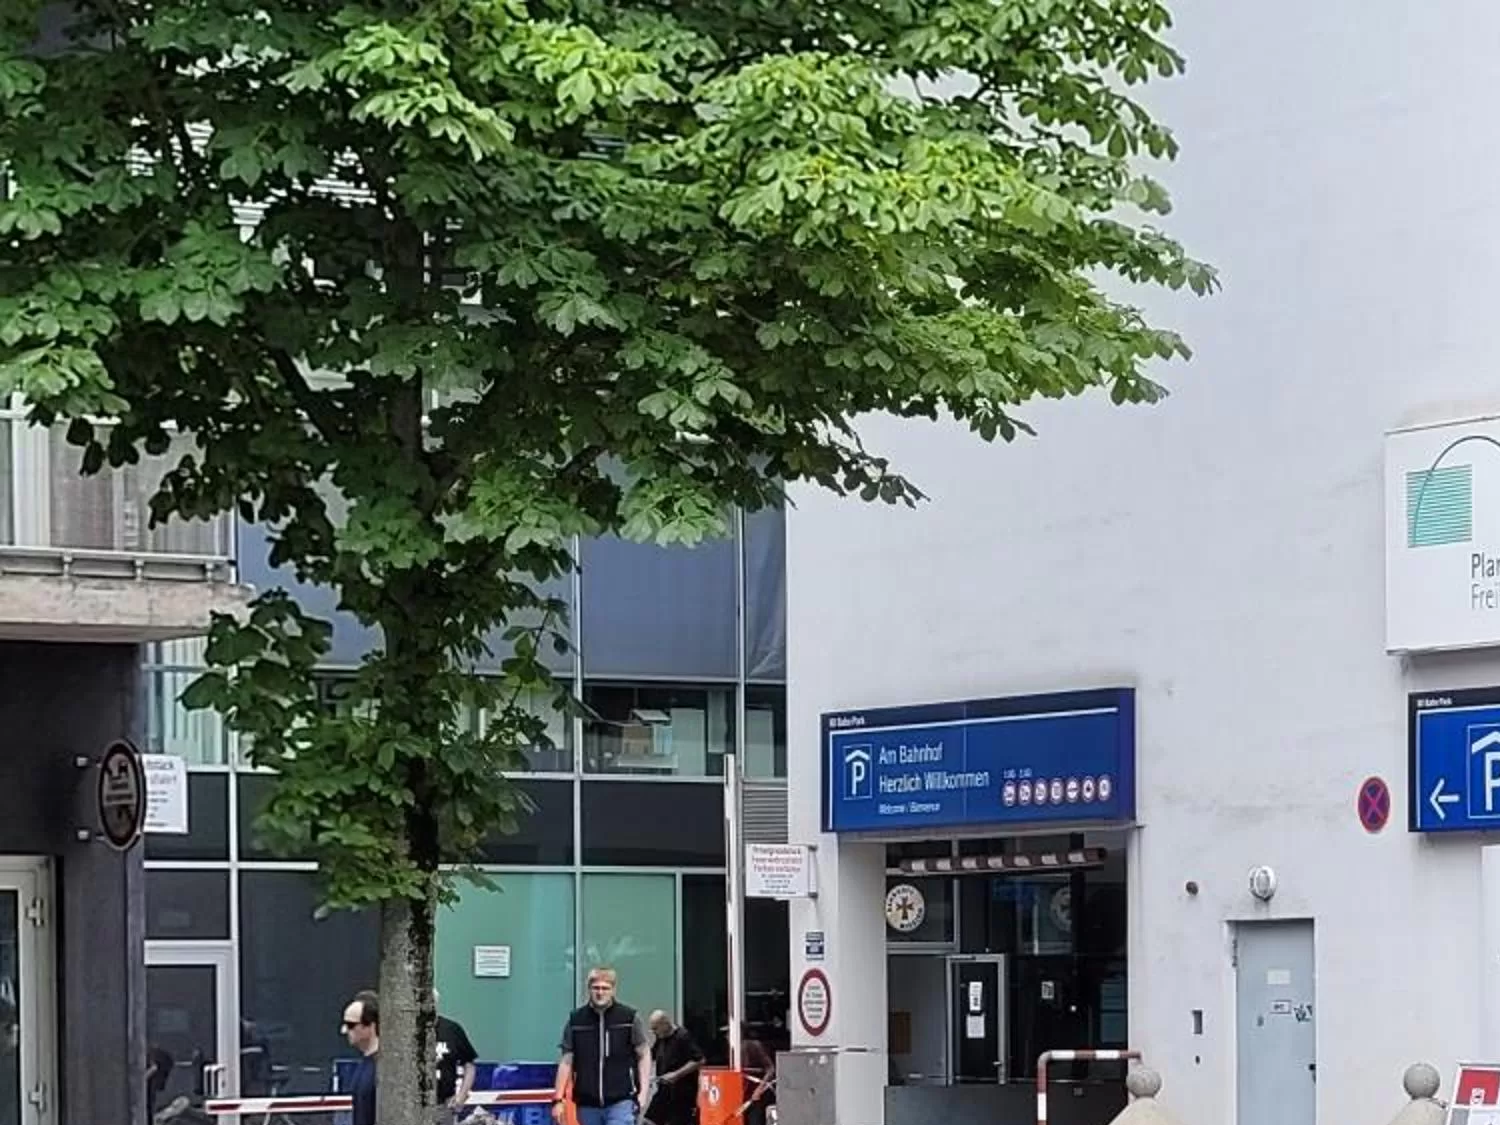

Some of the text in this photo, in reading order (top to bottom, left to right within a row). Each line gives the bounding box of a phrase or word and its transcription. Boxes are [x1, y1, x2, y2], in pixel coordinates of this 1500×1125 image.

[879, 741, 944, 765] Am Bahnhof
[851, 760, 865, 796] P
[879, 772, 921, 794] Herzlich
[923, 771, 990, 791] Willkommen
